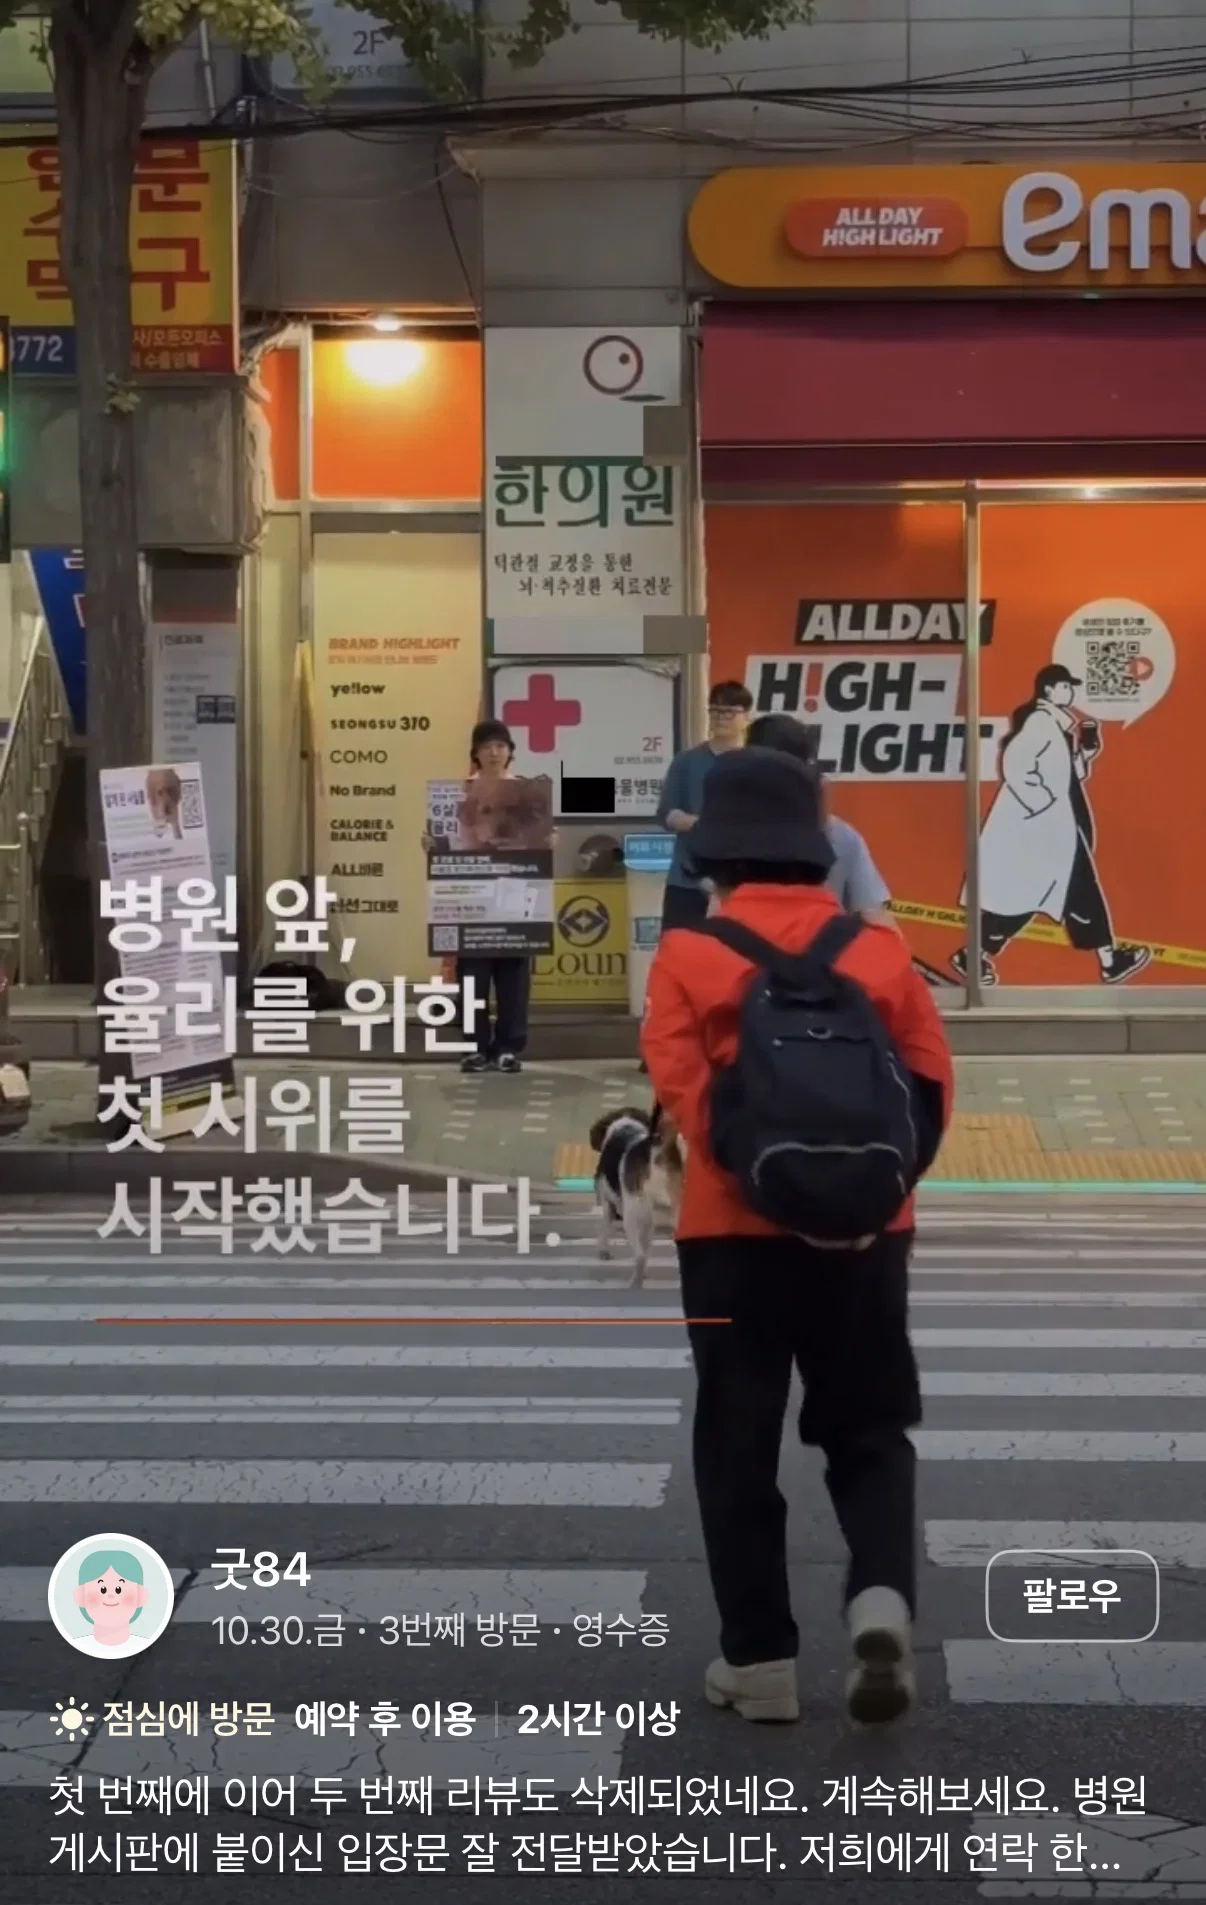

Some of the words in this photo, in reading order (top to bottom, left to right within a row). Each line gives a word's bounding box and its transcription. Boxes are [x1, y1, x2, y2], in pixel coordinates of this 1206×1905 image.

[352, 30, 385, 55] 2F
[1003, 171, 1206, 272] em
[494, 464, 674, 528] 한의원
[548, 553, 594, 573] 교정을
[604, 553, 633, 573] 통한
[611, 576, 672, 596] 치료전문
[800, 603, 989, 642] ALLDAY
[329, 638, 379, 650] BRAND
[330, 719, 397, 730] SEONGSU
[400, 716, 431, 731] 310
[642, 736, 663, 752] 2F
[807, 722, 994, 774] LIGHT
[330, 750, 388, 764] COMO
[330, 784, 349, 796] No
[352, 784, 396, 796] Brand
[613, 778, 664, 797] 물병원
[330, 819, 383, 830] CALORIE
[330, 831, 388, 842] BALANCE
